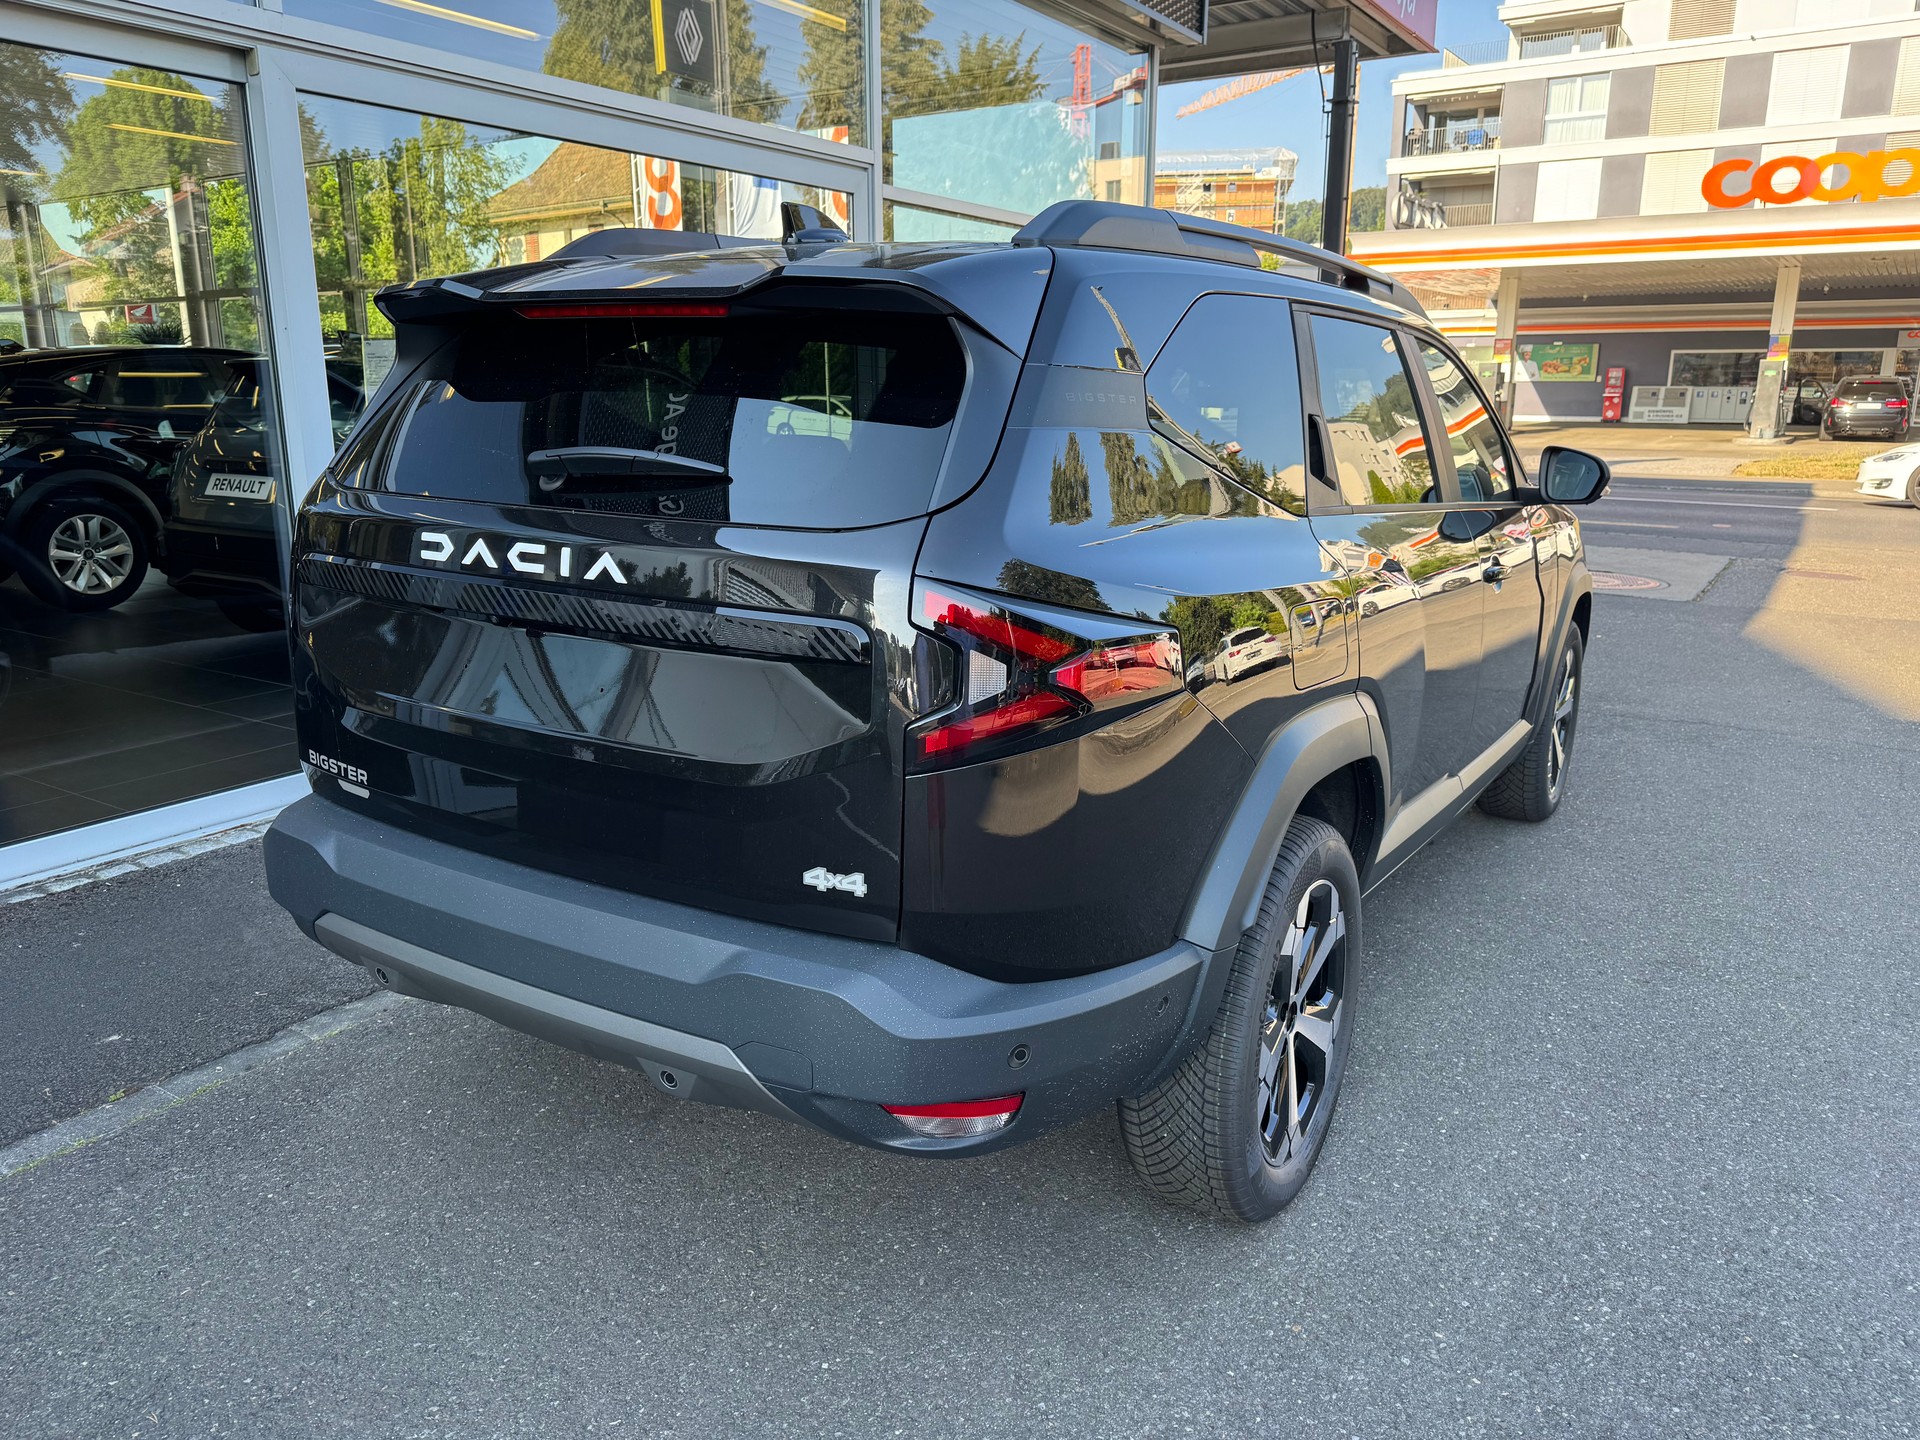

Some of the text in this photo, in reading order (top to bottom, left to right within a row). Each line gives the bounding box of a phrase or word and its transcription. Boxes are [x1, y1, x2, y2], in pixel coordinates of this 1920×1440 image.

[1701, 148, 1920, 208] coop
[1065, 392, 1137, 405] BIGSTER
[212, 478, 266, 494] RENAULT
[420, 532, 628, 585] DACIA
[308, 748, 368, 785] BIGSTER
[803, 867, 868, 897] 4x4
